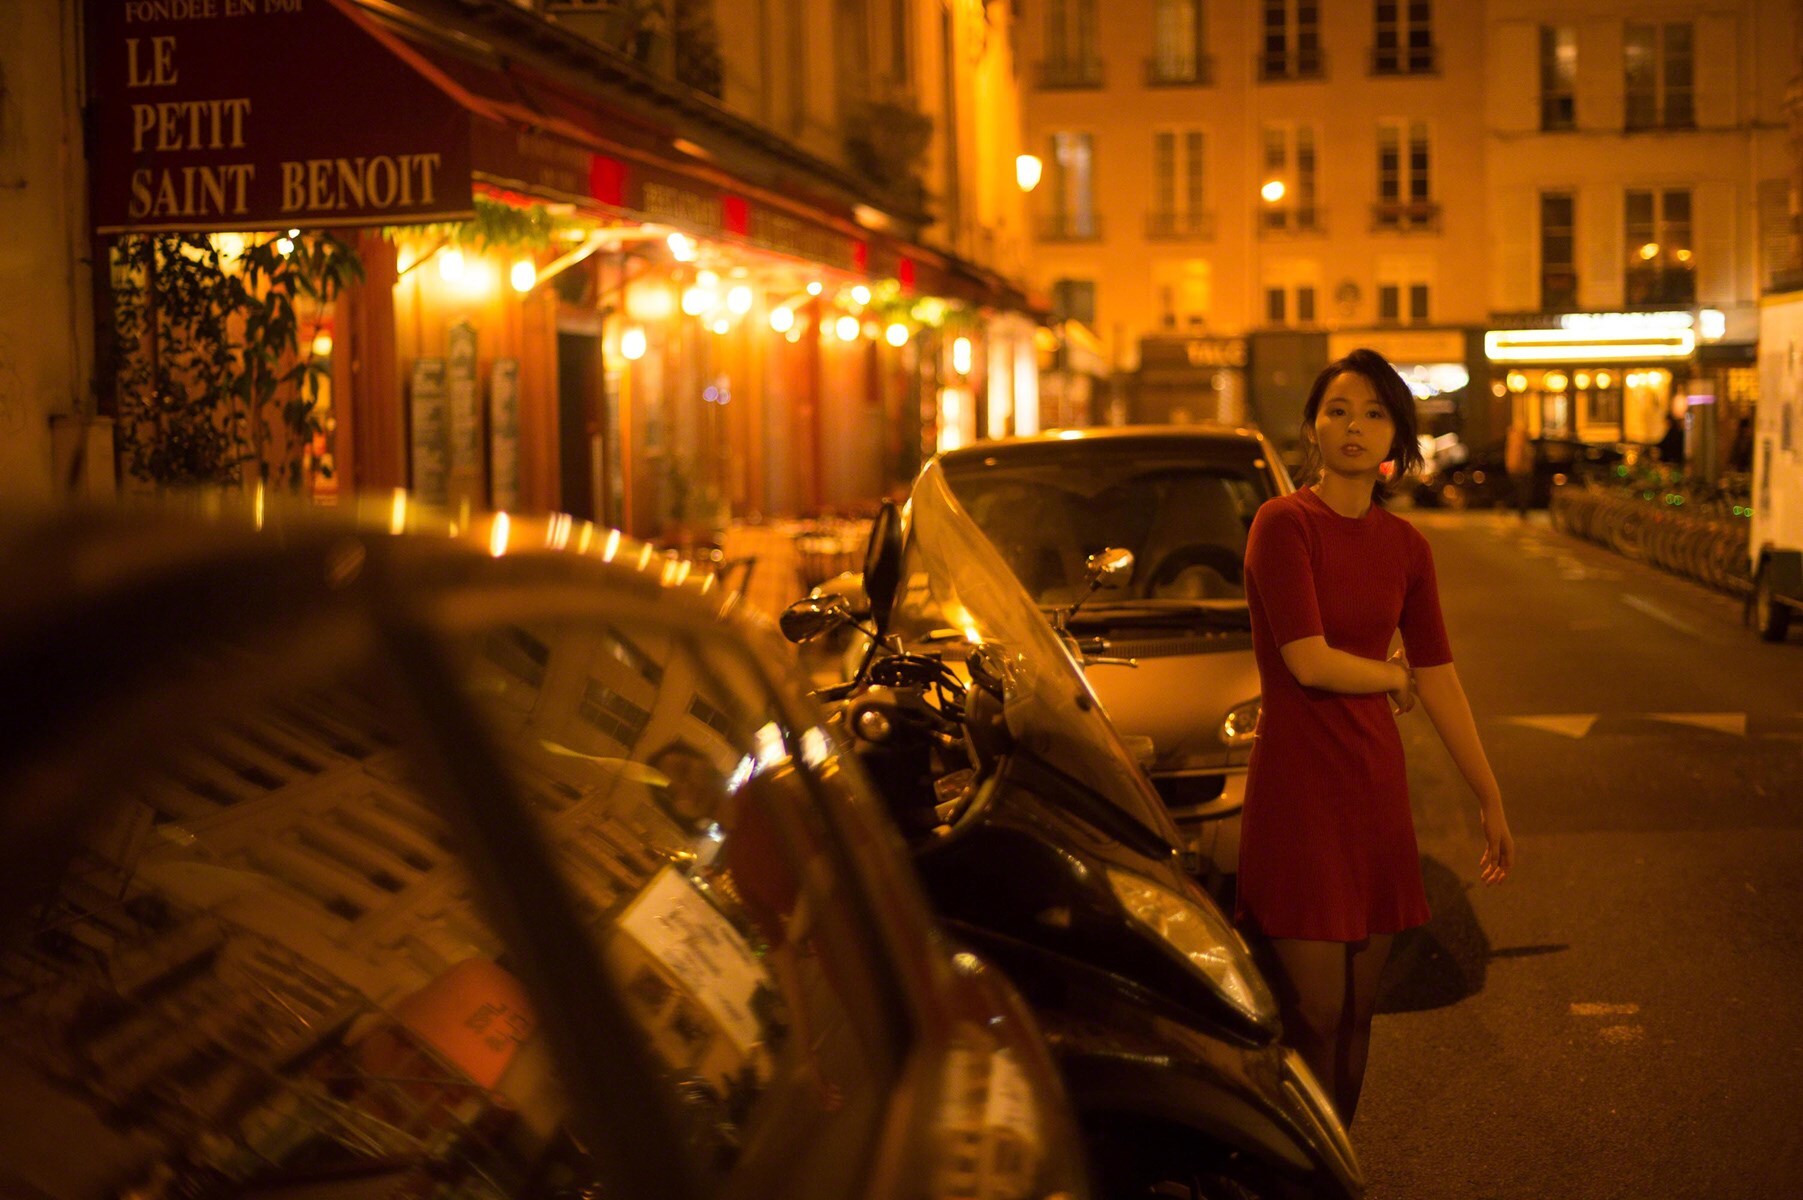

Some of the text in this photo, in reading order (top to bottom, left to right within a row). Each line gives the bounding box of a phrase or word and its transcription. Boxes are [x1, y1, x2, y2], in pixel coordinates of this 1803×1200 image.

[225, 0, 257, 17] EN
[126, 36, 179, 88] LE
[131, 98, 252, 152] PETIT
[128, 153, 442, 219] SAINT BENOIT
